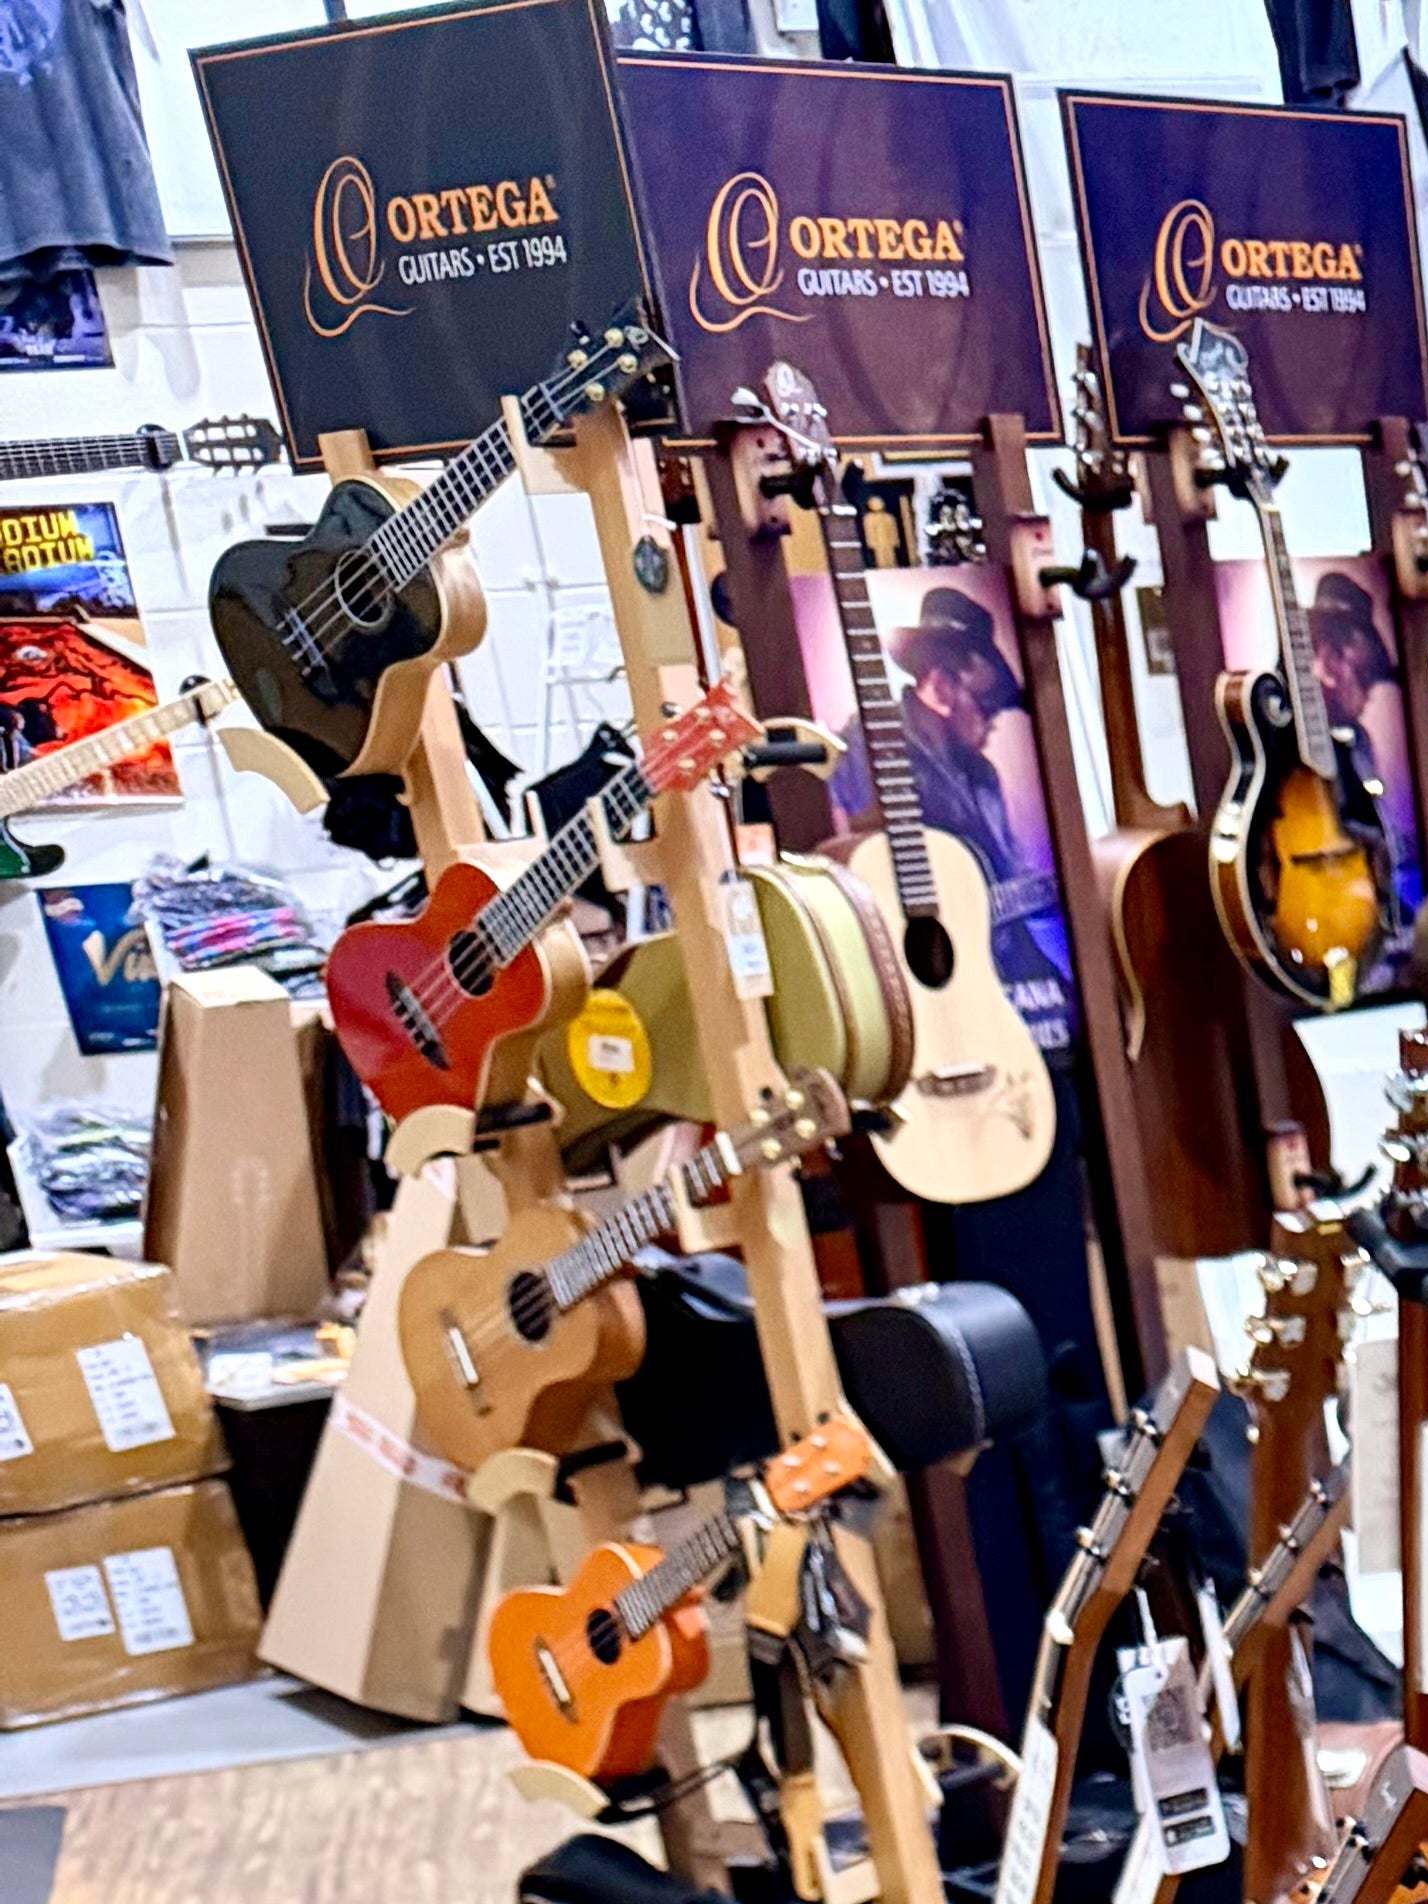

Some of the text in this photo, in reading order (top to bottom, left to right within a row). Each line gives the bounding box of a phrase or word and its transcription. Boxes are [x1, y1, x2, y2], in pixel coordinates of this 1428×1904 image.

[386, 176, 559, 243] ORTEGA
[399, 235, 567, 285] GUITARS EST 1994
[789, 216, 965, 261] ORTEGA
[1220, 238, 1363, 281] ORTEGA
[797, 268, 970, 298] GUITARS EST 1994
